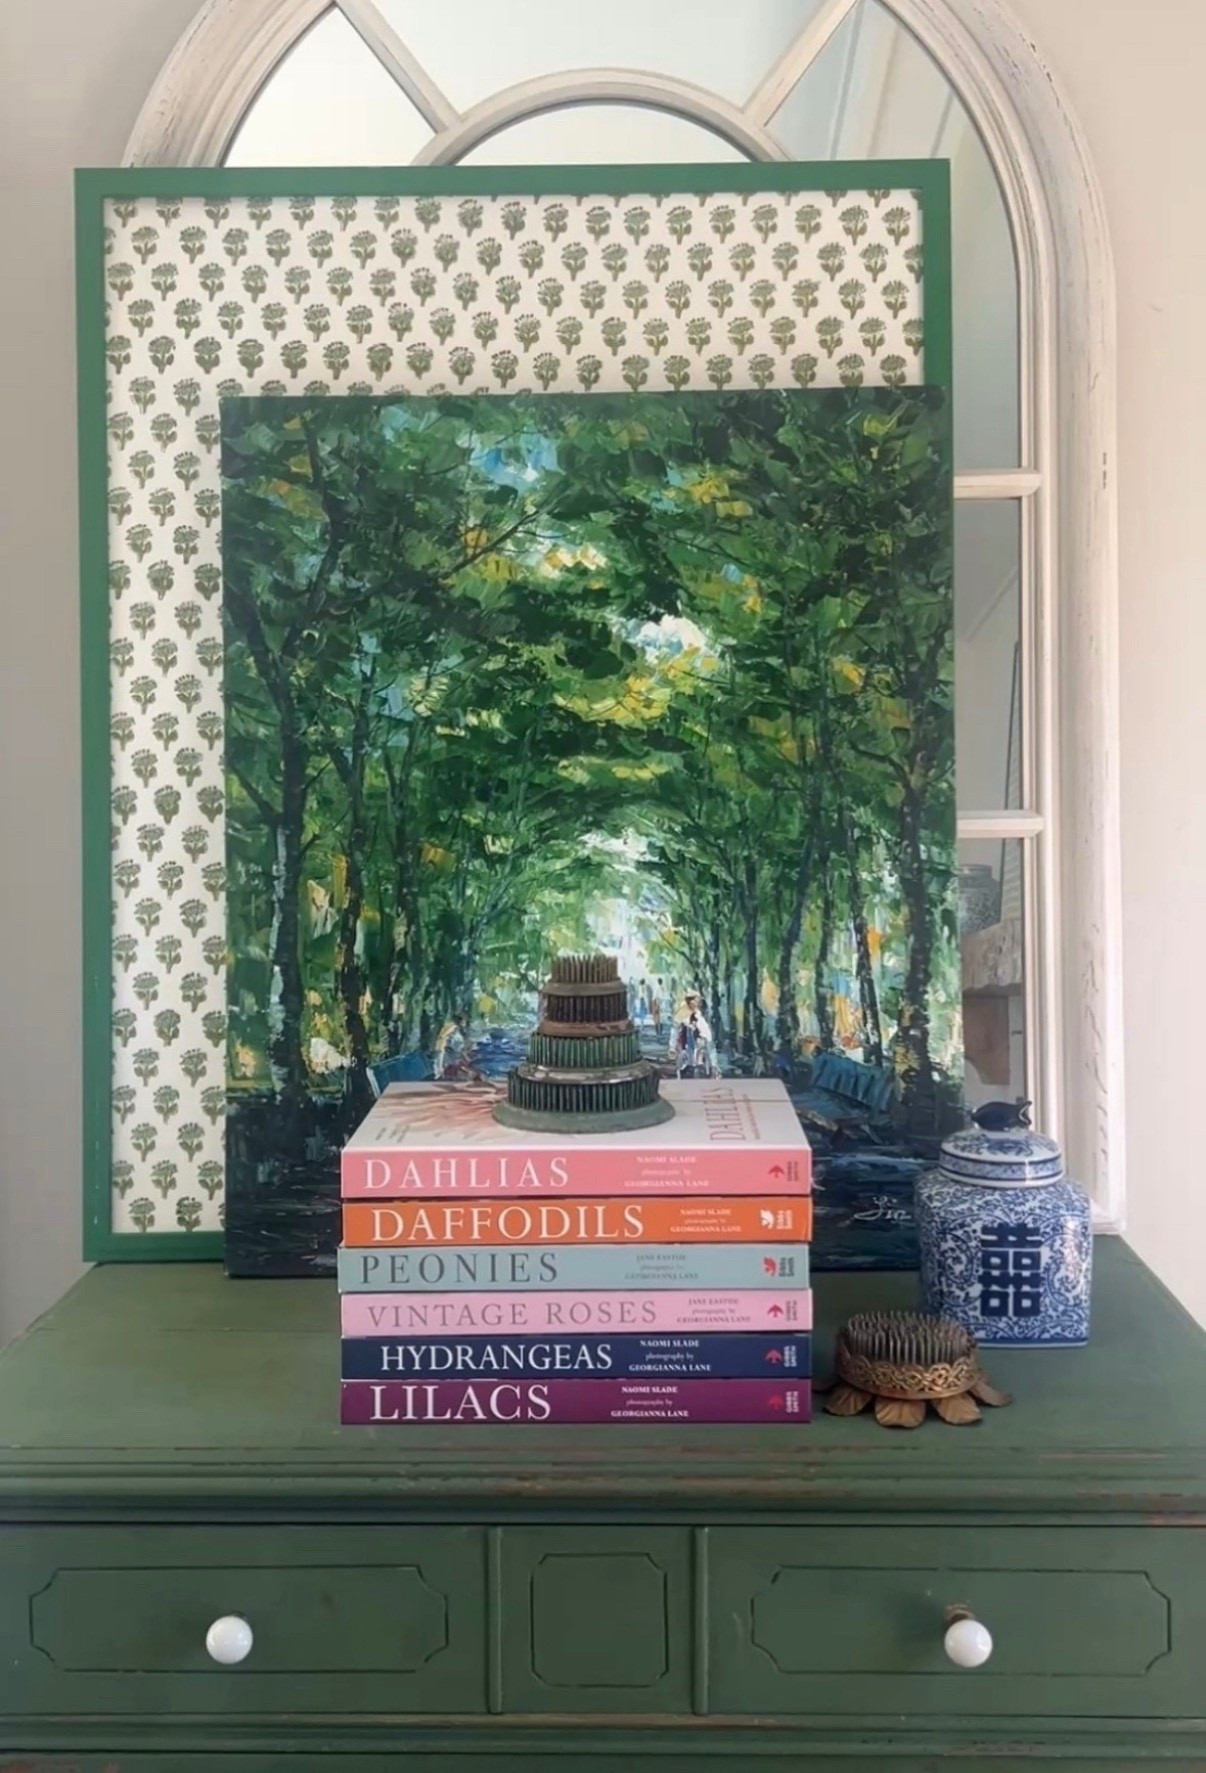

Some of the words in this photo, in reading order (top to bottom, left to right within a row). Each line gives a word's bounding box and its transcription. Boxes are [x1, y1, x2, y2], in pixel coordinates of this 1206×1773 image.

[636, 1156, 667, 1164] NAOMI
[669, 1156, 697, 1164] SLADE
[364, 1158, 569, 1188] DAHLIAS
[624, 1179, 684, 1188] GEORGIANNA
[686, 1179, 709, 1187] LANE
[680, 1208, 706, 1216] NAOMI
[707, 1208, 732, 1216] SLADE
[373, 1205, 644, 1241] DAFFODILS
[670, 1225, 720, 1233] GEORGIANNA
[721, 1225, 742, 1233] LANE
[361, 1253, 559, 1284] PEONIES
[678, 1272, 698, 1280] LANE
[367, 1303, 528, 1328] VINTAGE
[546, 1300, 657, 1324] ROSES
[677, 1316, 730, 1324] GEORGIANNA
[640, 1340, 671, 1348] NAOMI
[381, 1343, 612, 1371] HYDRANGEAS
[645, 1352, 685, 1361] photography
[686, 1352, 695, 1361] by
[629, 1364, 688, 1372] GEORGIANNA
[689, 1364, 712, 1372] LANE
[370, 1384, 551, 1420] LILACS
[610, 1410, 666, 1418] GEORGIANNA
